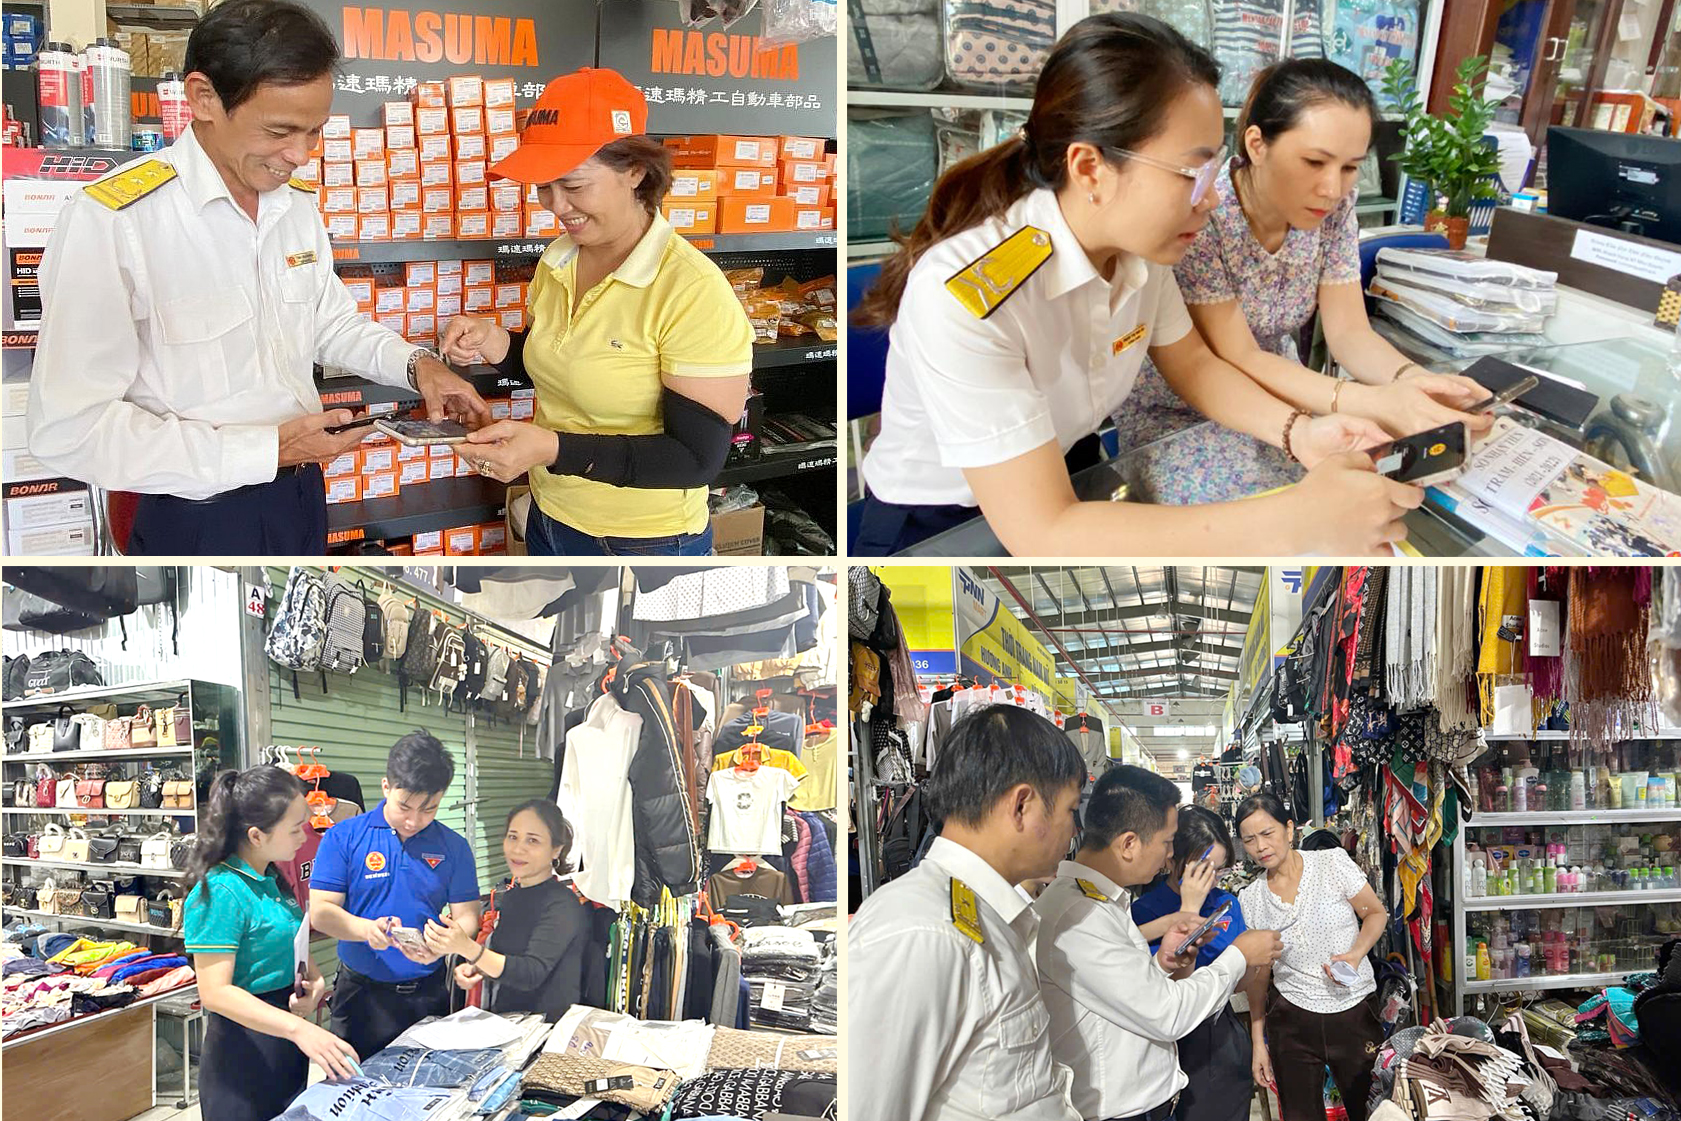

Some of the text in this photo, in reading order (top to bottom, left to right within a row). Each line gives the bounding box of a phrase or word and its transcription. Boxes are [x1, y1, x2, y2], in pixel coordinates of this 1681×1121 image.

[343, 7, 539, 67] MASUMA
[652, 28, 799, 81] MASUMA
[10, 482, 58, 496] BONAR
[251, 587, 261, 600] A
[248, 600, 265, 614] 48
[1151, 705, 1163, 715] B
